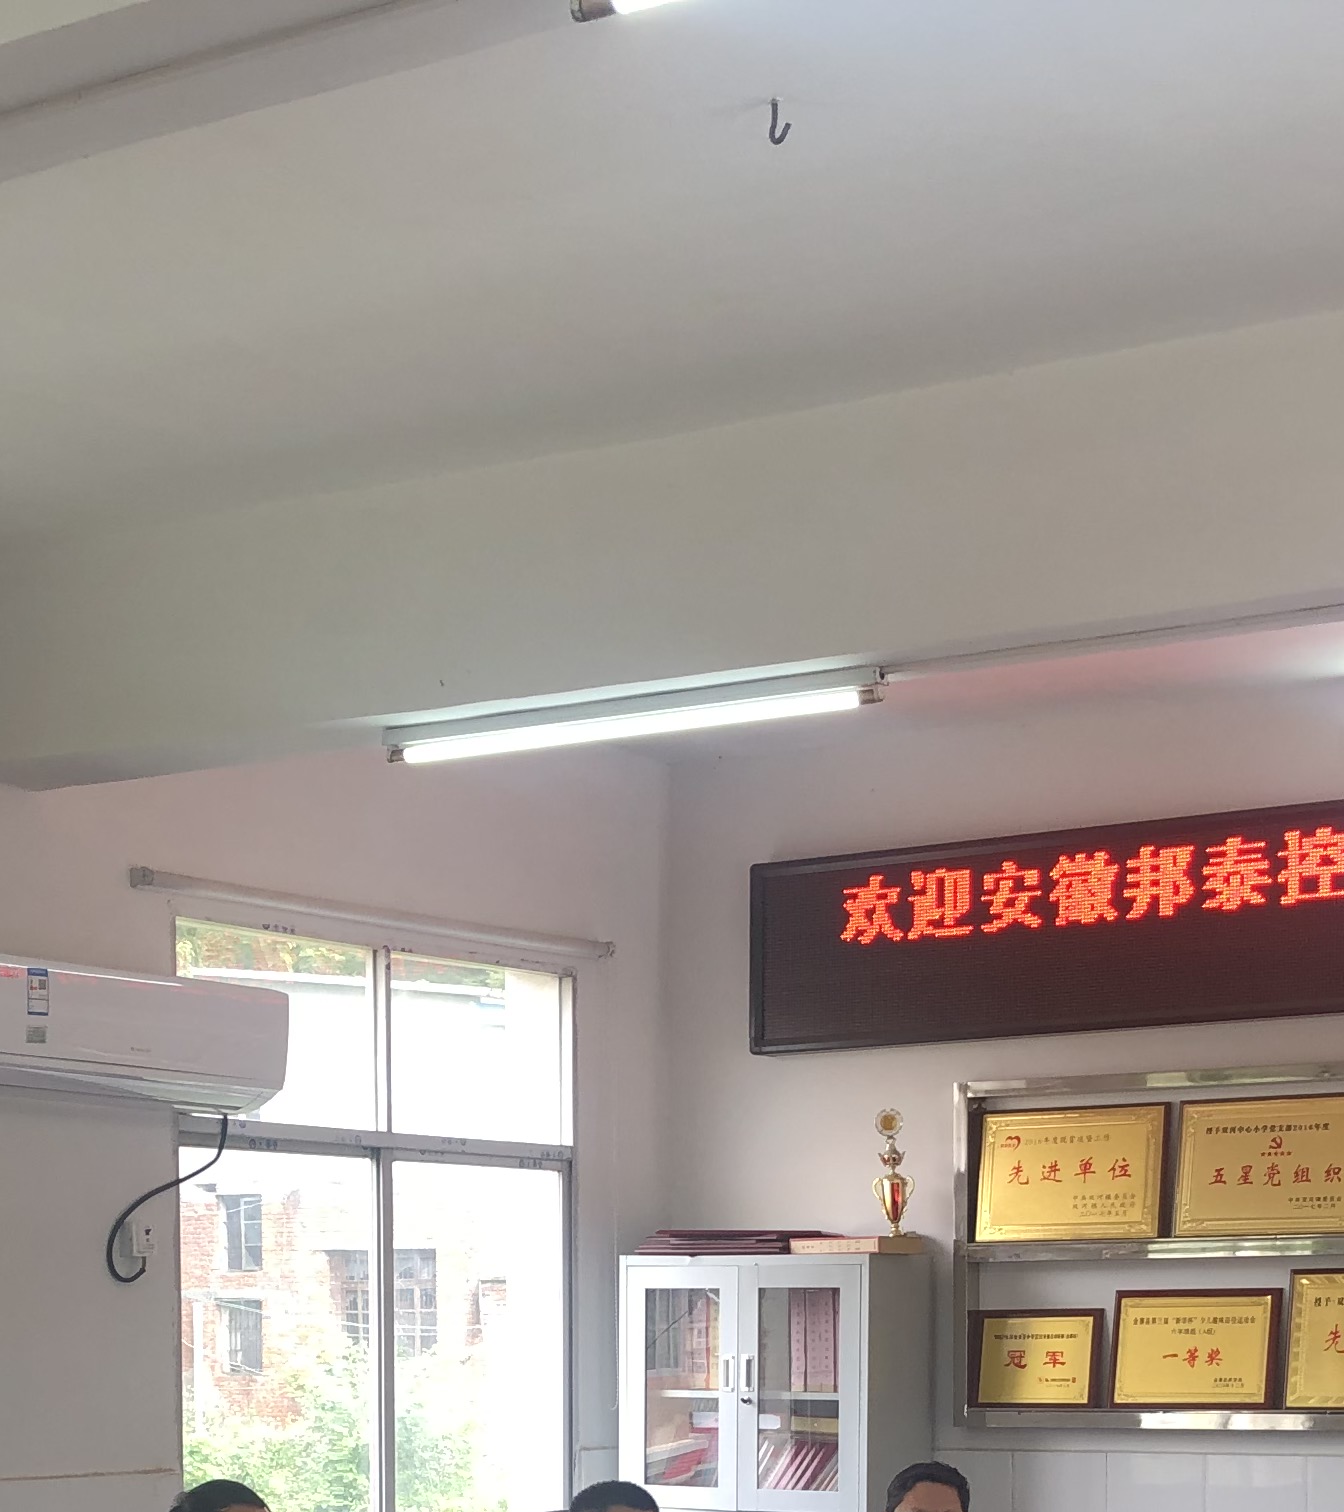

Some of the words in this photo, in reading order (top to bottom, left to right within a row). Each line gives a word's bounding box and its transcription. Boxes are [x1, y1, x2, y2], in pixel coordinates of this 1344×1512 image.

[1007, 1156, 1132, 1186] 先进单位
[1208, 1162, 1343, 1187] 五星党组织
[1003, 1349, 1067, 1370] 冠军
[1162, 1346, 1223, 1368] 一等奖
